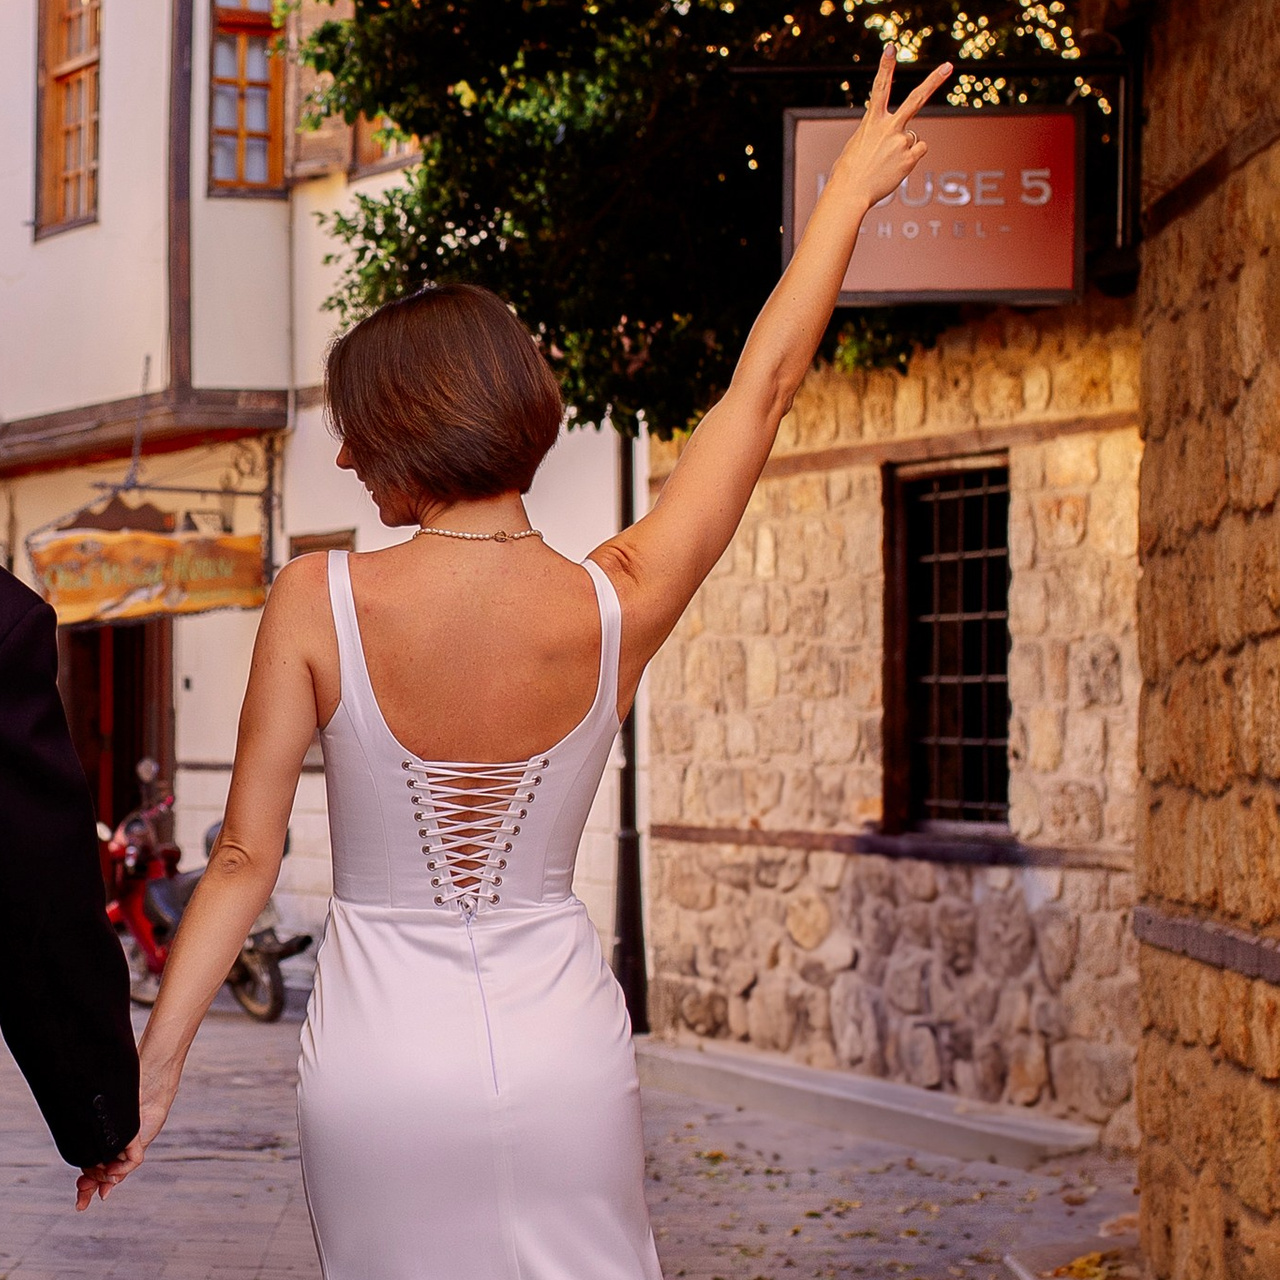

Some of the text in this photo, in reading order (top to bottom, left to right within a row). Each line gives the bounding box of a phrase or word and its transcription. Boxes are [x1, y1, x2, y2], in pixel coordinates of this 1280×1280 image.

[816, 168, 1053, 208] USE 5
[876, 220, 988, 240] HOTEL
